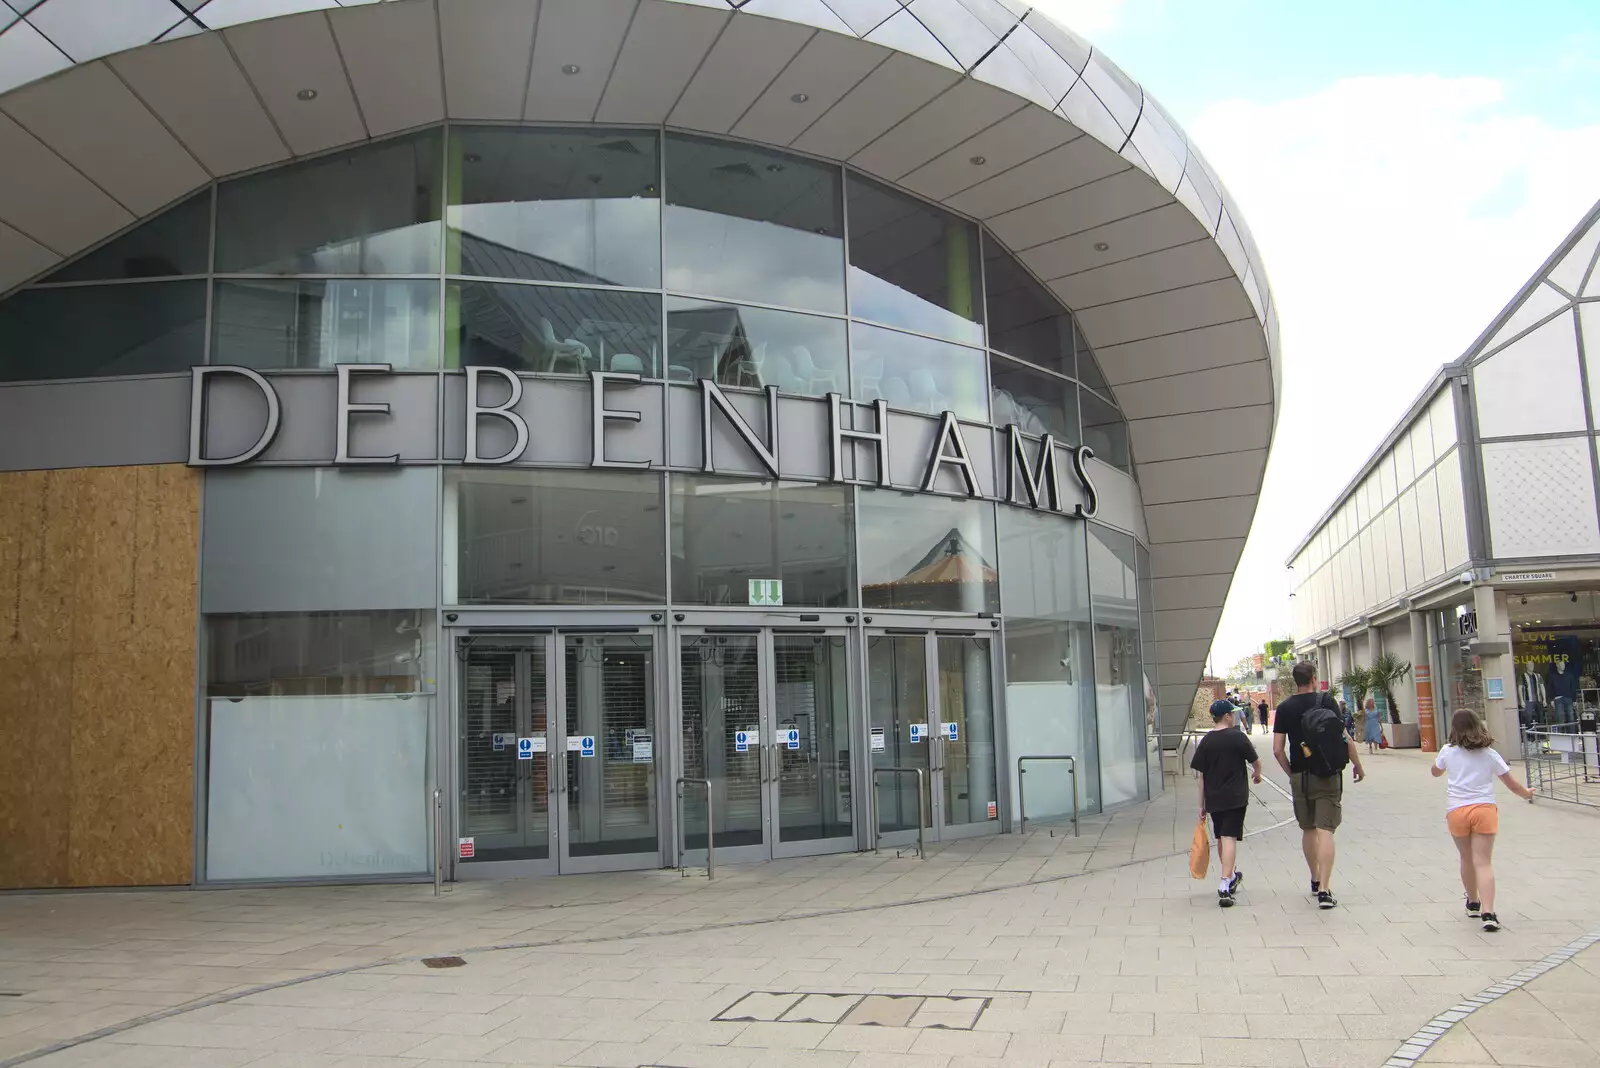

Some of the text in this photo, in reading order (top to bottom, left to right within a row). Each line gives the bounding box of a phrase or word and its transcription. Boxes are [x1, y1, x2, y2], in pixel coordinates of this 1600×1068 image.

[186, 363, 1098, 519] DEBENHAMS
[1522, 631, 1556, 642] LOVE
[1513, 653, 1570, 665] SUMMER
